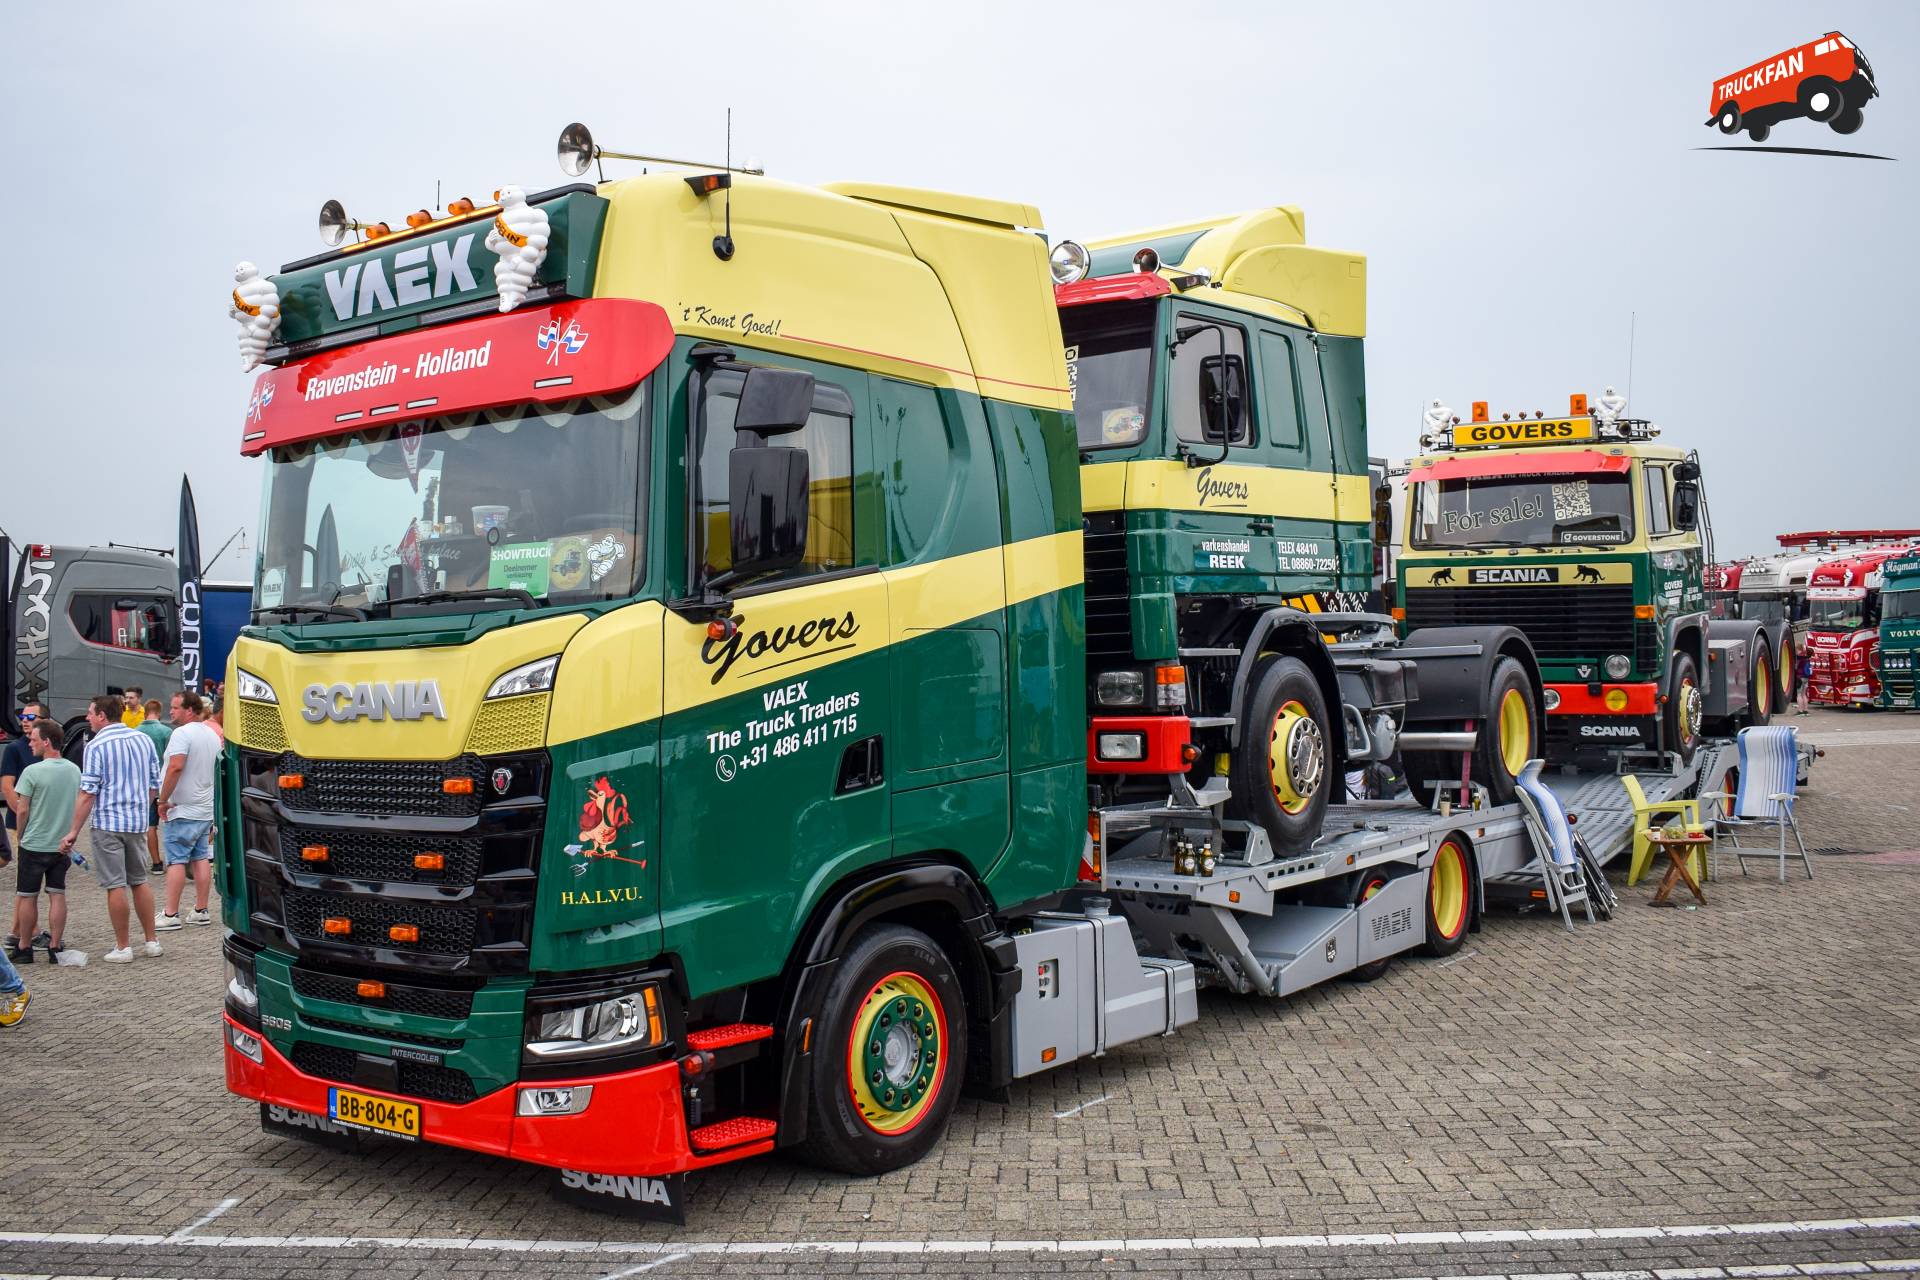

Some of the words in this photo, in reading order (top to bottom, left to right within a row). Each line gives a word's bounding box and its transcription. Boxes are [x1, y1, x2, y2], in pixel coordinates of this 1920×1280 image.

[324, 233, 478, 321] VAEX
[695, 306, 736, 329] Komt
[741, 313, 782, 337] Goed!
[304, 360, 397, 402] Ravenstein
[415, 340, 492, 379] Holland
[1470, 421, 1574, 442] GOVERS
[1196, 467, 1249, 506] Govers
[1443, 509, 1484, 534] For
[1490, 495, 1544, 523] sale!
[1202, 538, 1250, 553] varkenshandel
[1209, 554, 1246, 569] REEK
[1277, 542, 1295, 555] TELEX
[1296, 542, 1318, 555] 48410
[1475, 568, 1551, 584] SCANIA
[701, 611, 860, 685] Govers
[301, 679, 448, 723] SCANIA
[763, 681, 809, 712] VAEX
[707, 729, 742, 754] The
[746, 710, 796, 742] Truck
[799, 691, 860, 724] Traders
[1580, 725, 1641, 737] SCANIA
[739, 743, 767, 770] +31
[772, 733, 800, 758] 486
[803, 723, 828, 748] 411
[832, 713, 857, 739] 715
[561, 886, 643, 905] H.A.L.V.U.
[391, 1048, 440, 1063] INTERCOOLER
[340, 1094, 414, 1130] BB-804-G
[561, 1168, 672, 1207] SCANIA
